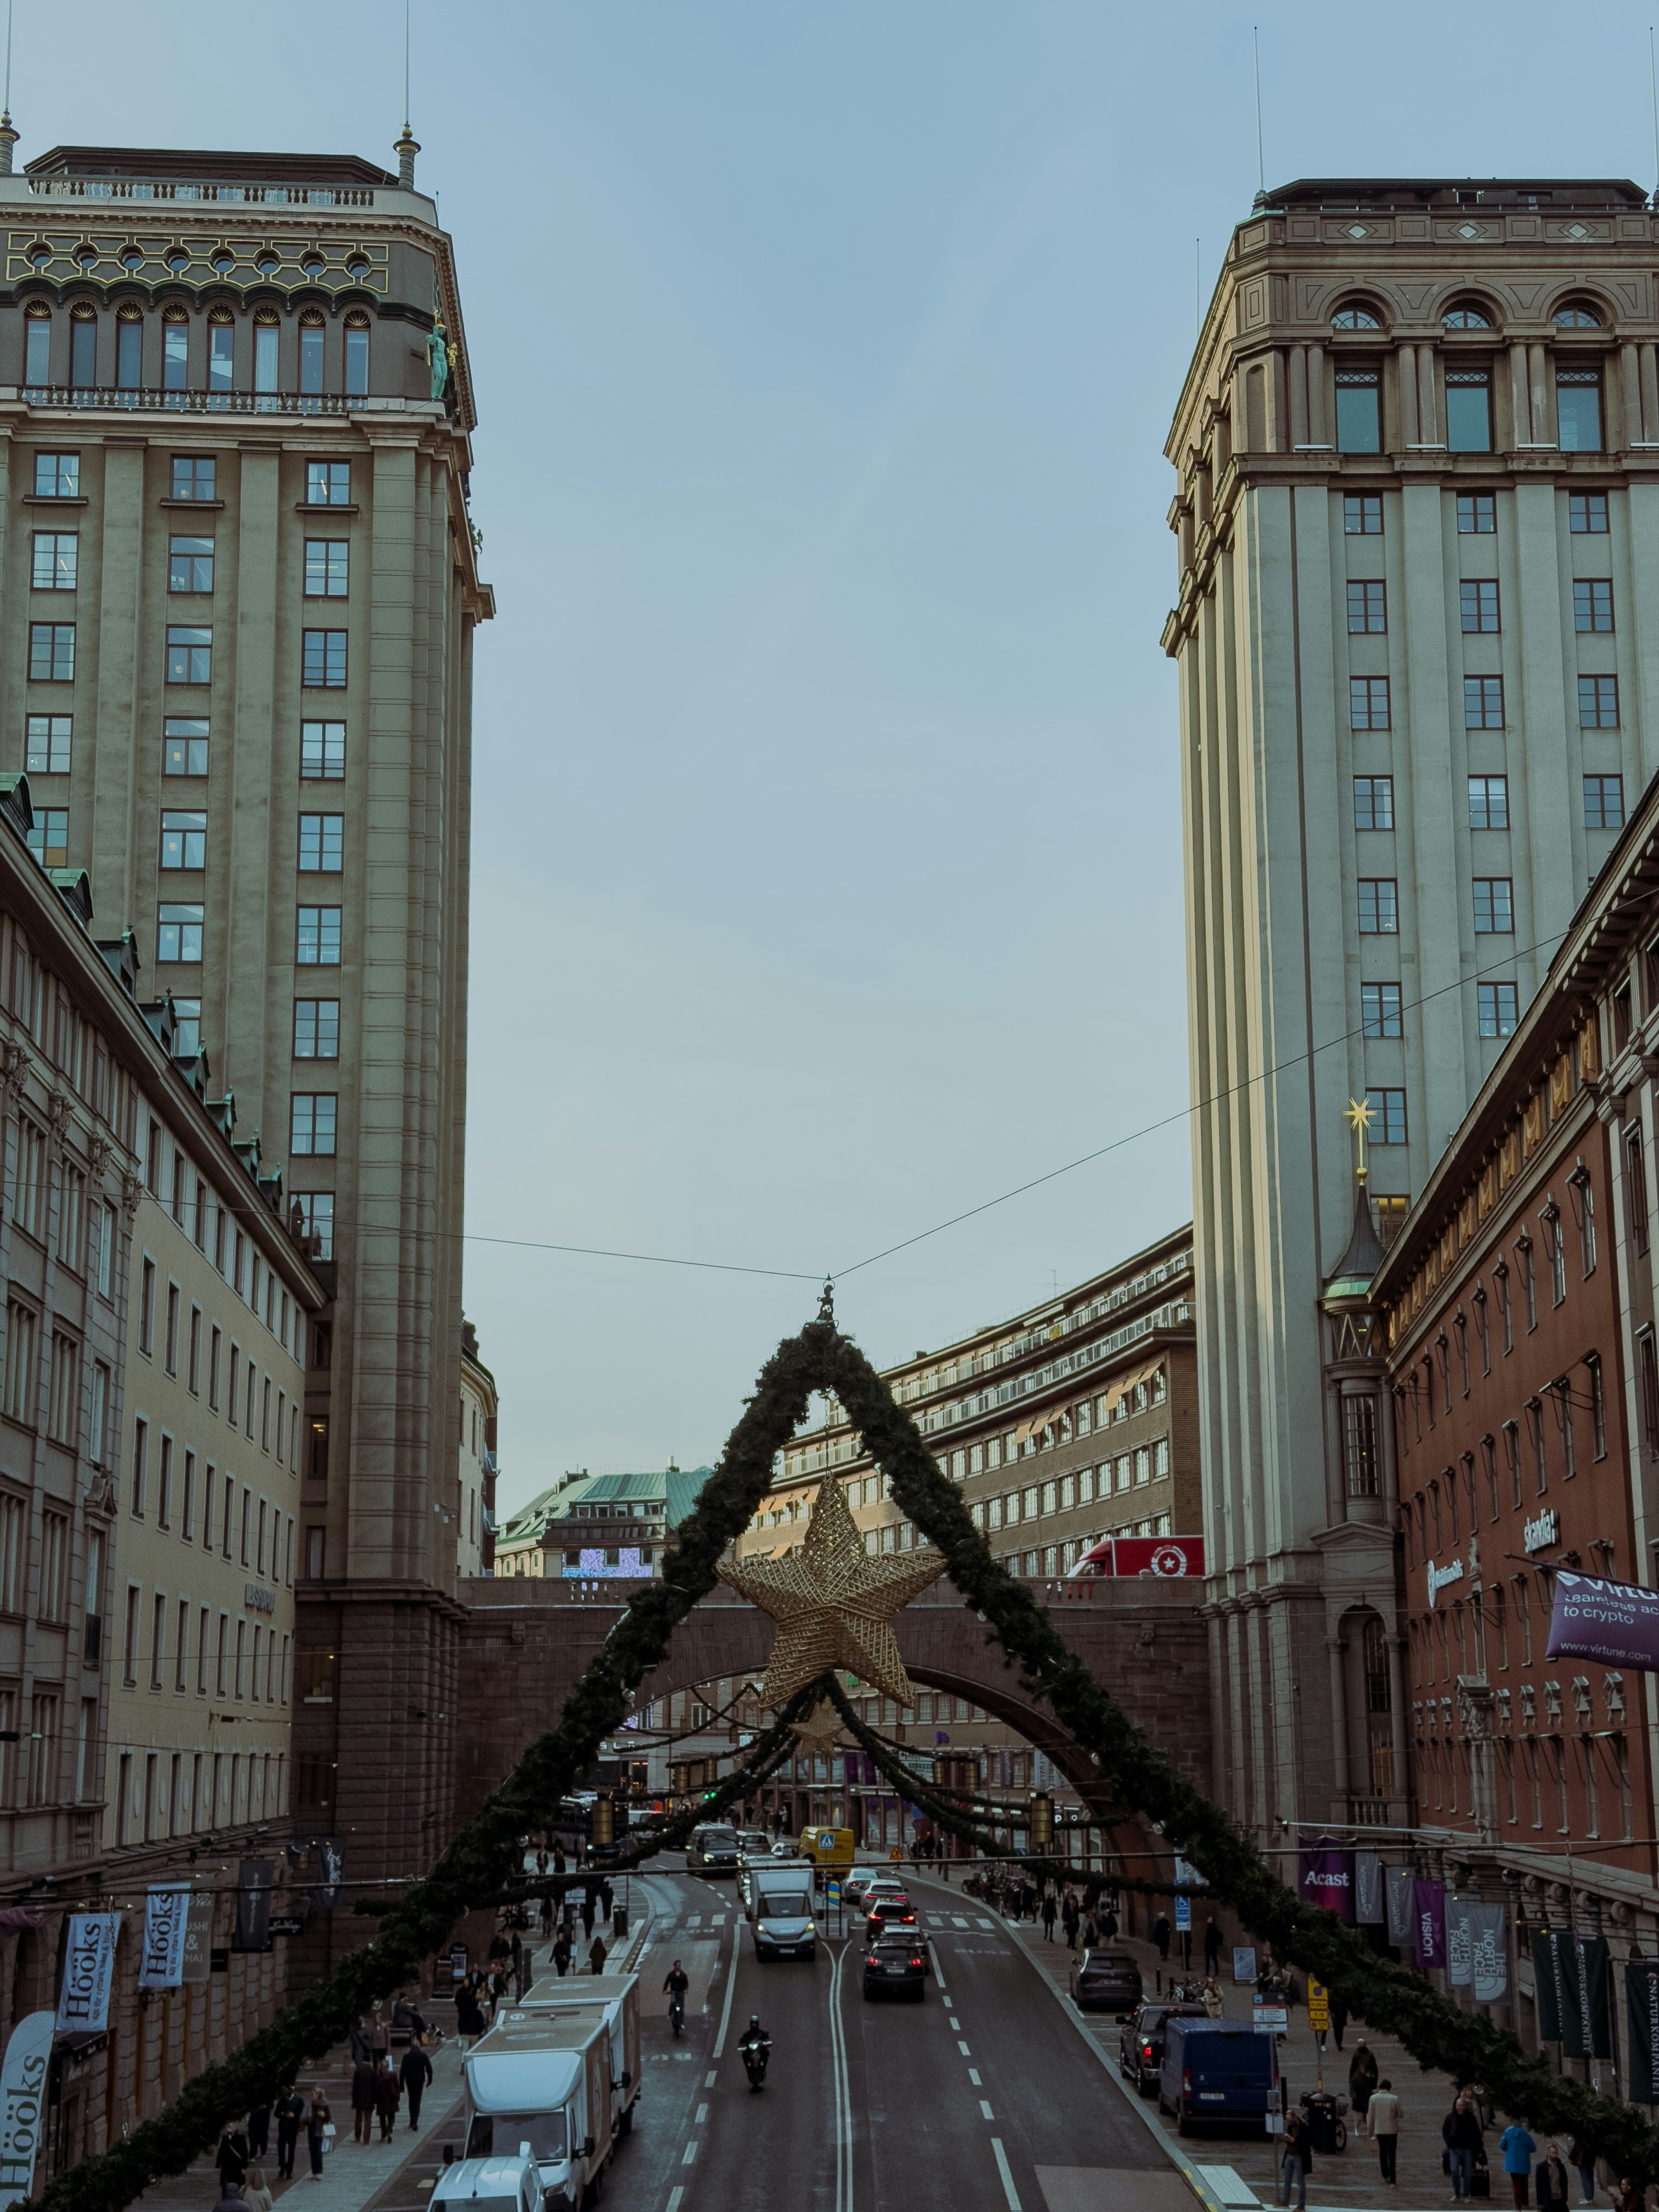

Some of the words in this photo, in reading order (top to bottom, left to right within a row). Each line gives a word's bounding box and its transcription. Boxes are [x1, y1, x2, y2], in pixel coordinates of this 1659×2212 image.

[1564, 1605, 1579, 1617] to
[1583, 1608, 1634, 1624] crypto
[1560, 1642, 1651, 1661] www.virtune.com
[1304, 1871, 1350, 1887] Acast
[146, 1893, 174, 1976] Hööks
[187, 1933, 199, 1950] &
[1449, 1929, 1461, 1962] FACE
[1459, 1918, 1470, 1962] NORTH
[1473, 1942, 1486, 1976] FACE
[1483, 1929, 1496, 1976] NORTH
[1495, 1951, 1506, 1976] THE
[65, 1923, 101, 2021] Hööks
[0, 2055, 46, 2194] Hööks
